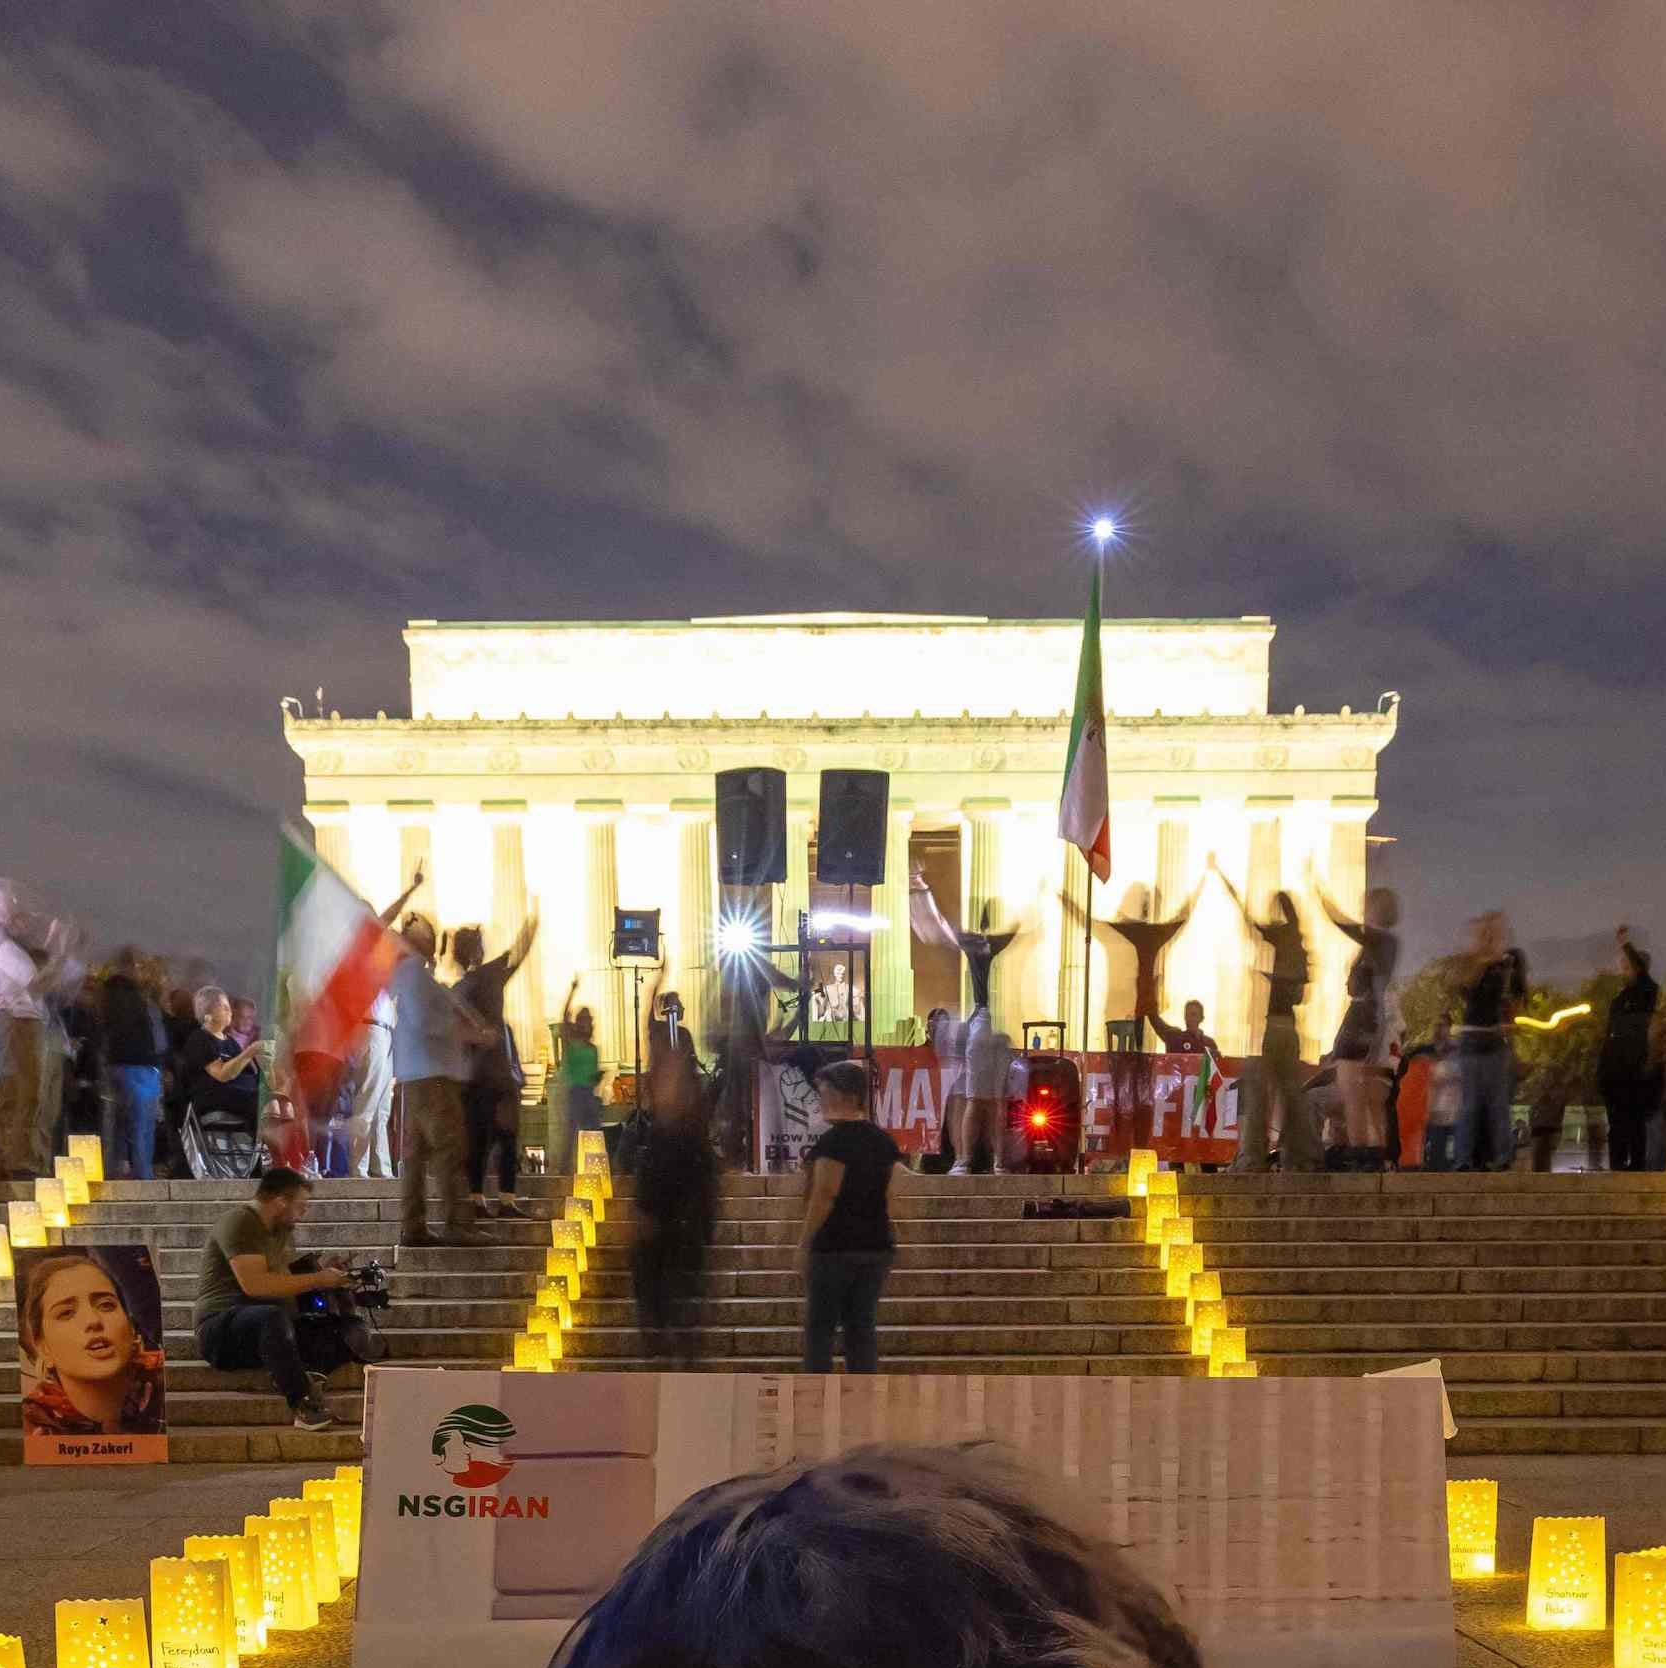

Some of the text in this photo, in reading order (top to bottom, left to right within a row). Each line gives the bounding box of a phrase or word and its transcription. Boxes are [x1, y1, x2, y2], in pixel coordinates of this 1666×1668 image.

[58, 1441, 133, 1458] Roya Zakeri
[398, 1494, 549, 1519] NSGIRAN
